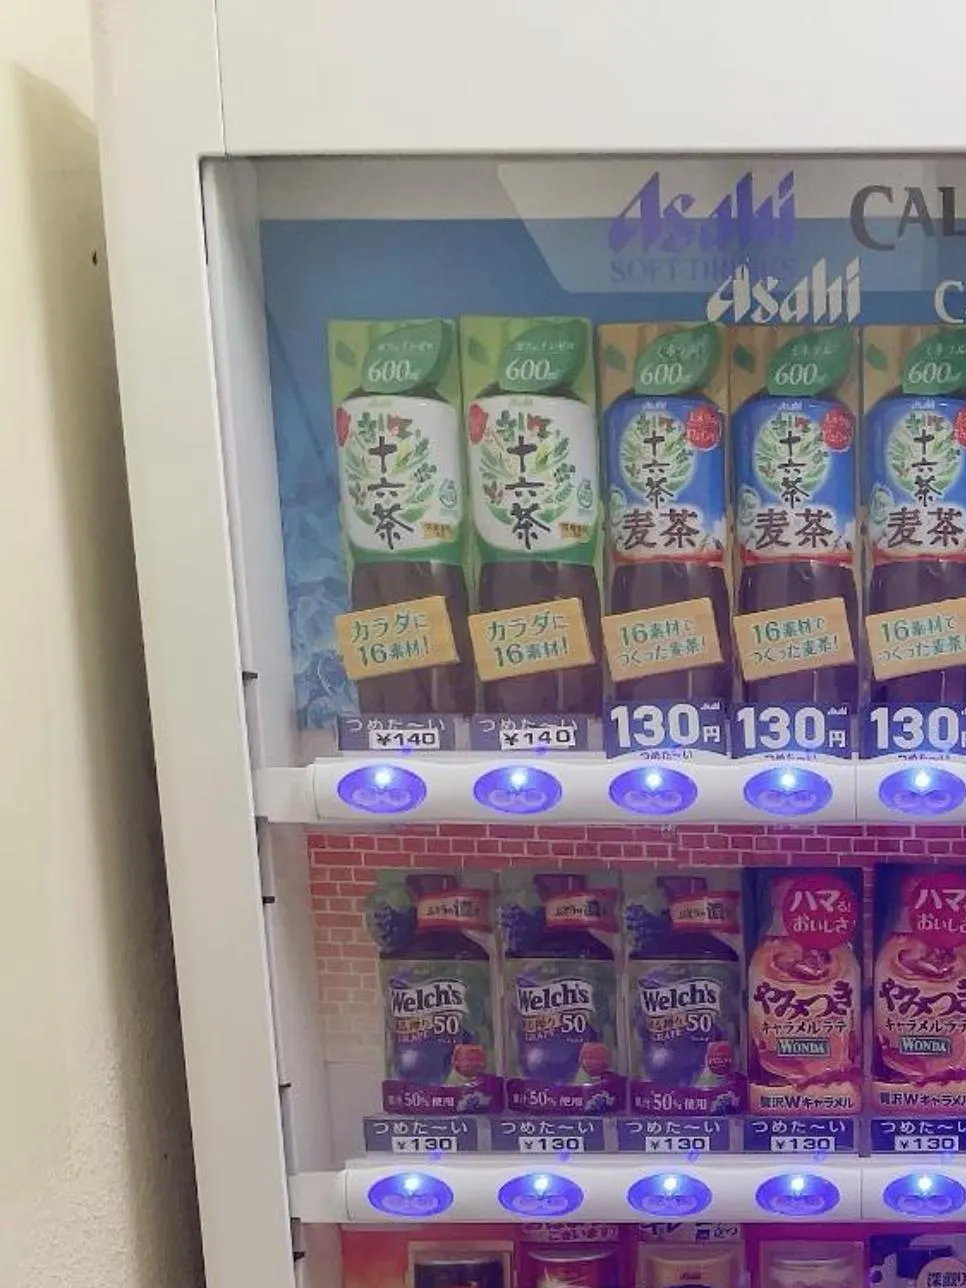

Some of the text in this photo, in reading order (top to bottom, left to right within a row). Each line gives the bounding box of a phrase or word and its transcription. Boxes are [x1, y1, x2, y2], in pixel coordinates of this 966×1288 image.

[607, 170, 796, 253] Asahi
[706, 256, 861, 324] Asahi
[367, 435, 414, 550] 十六茶
[504, 435, 550, 550] 十六茶
[622, 509, 699, 550] 麦茶
[755, 508, 833, 550] 麦茶
[888, 507, 964, 549] 麦茶
[351, 613, 428, 642] カラダに
[487, 612, 569, 643] カラダに
[392, 983, 463, 1013] Welch's
[518, 983, 589, 1012] Welch's
[642, 984, 717, 1013] Welch's
[433, 1016, 458, 1034] 50
[561, 1014, 586, 1033] 50
[687, 1015, 713, 1033] 50
[762, 1021, 847, 1034] キャラメルラテ
[780, 1040, 825, 1053] WONDA
[903, 1038, 946, 1051] WONDA
